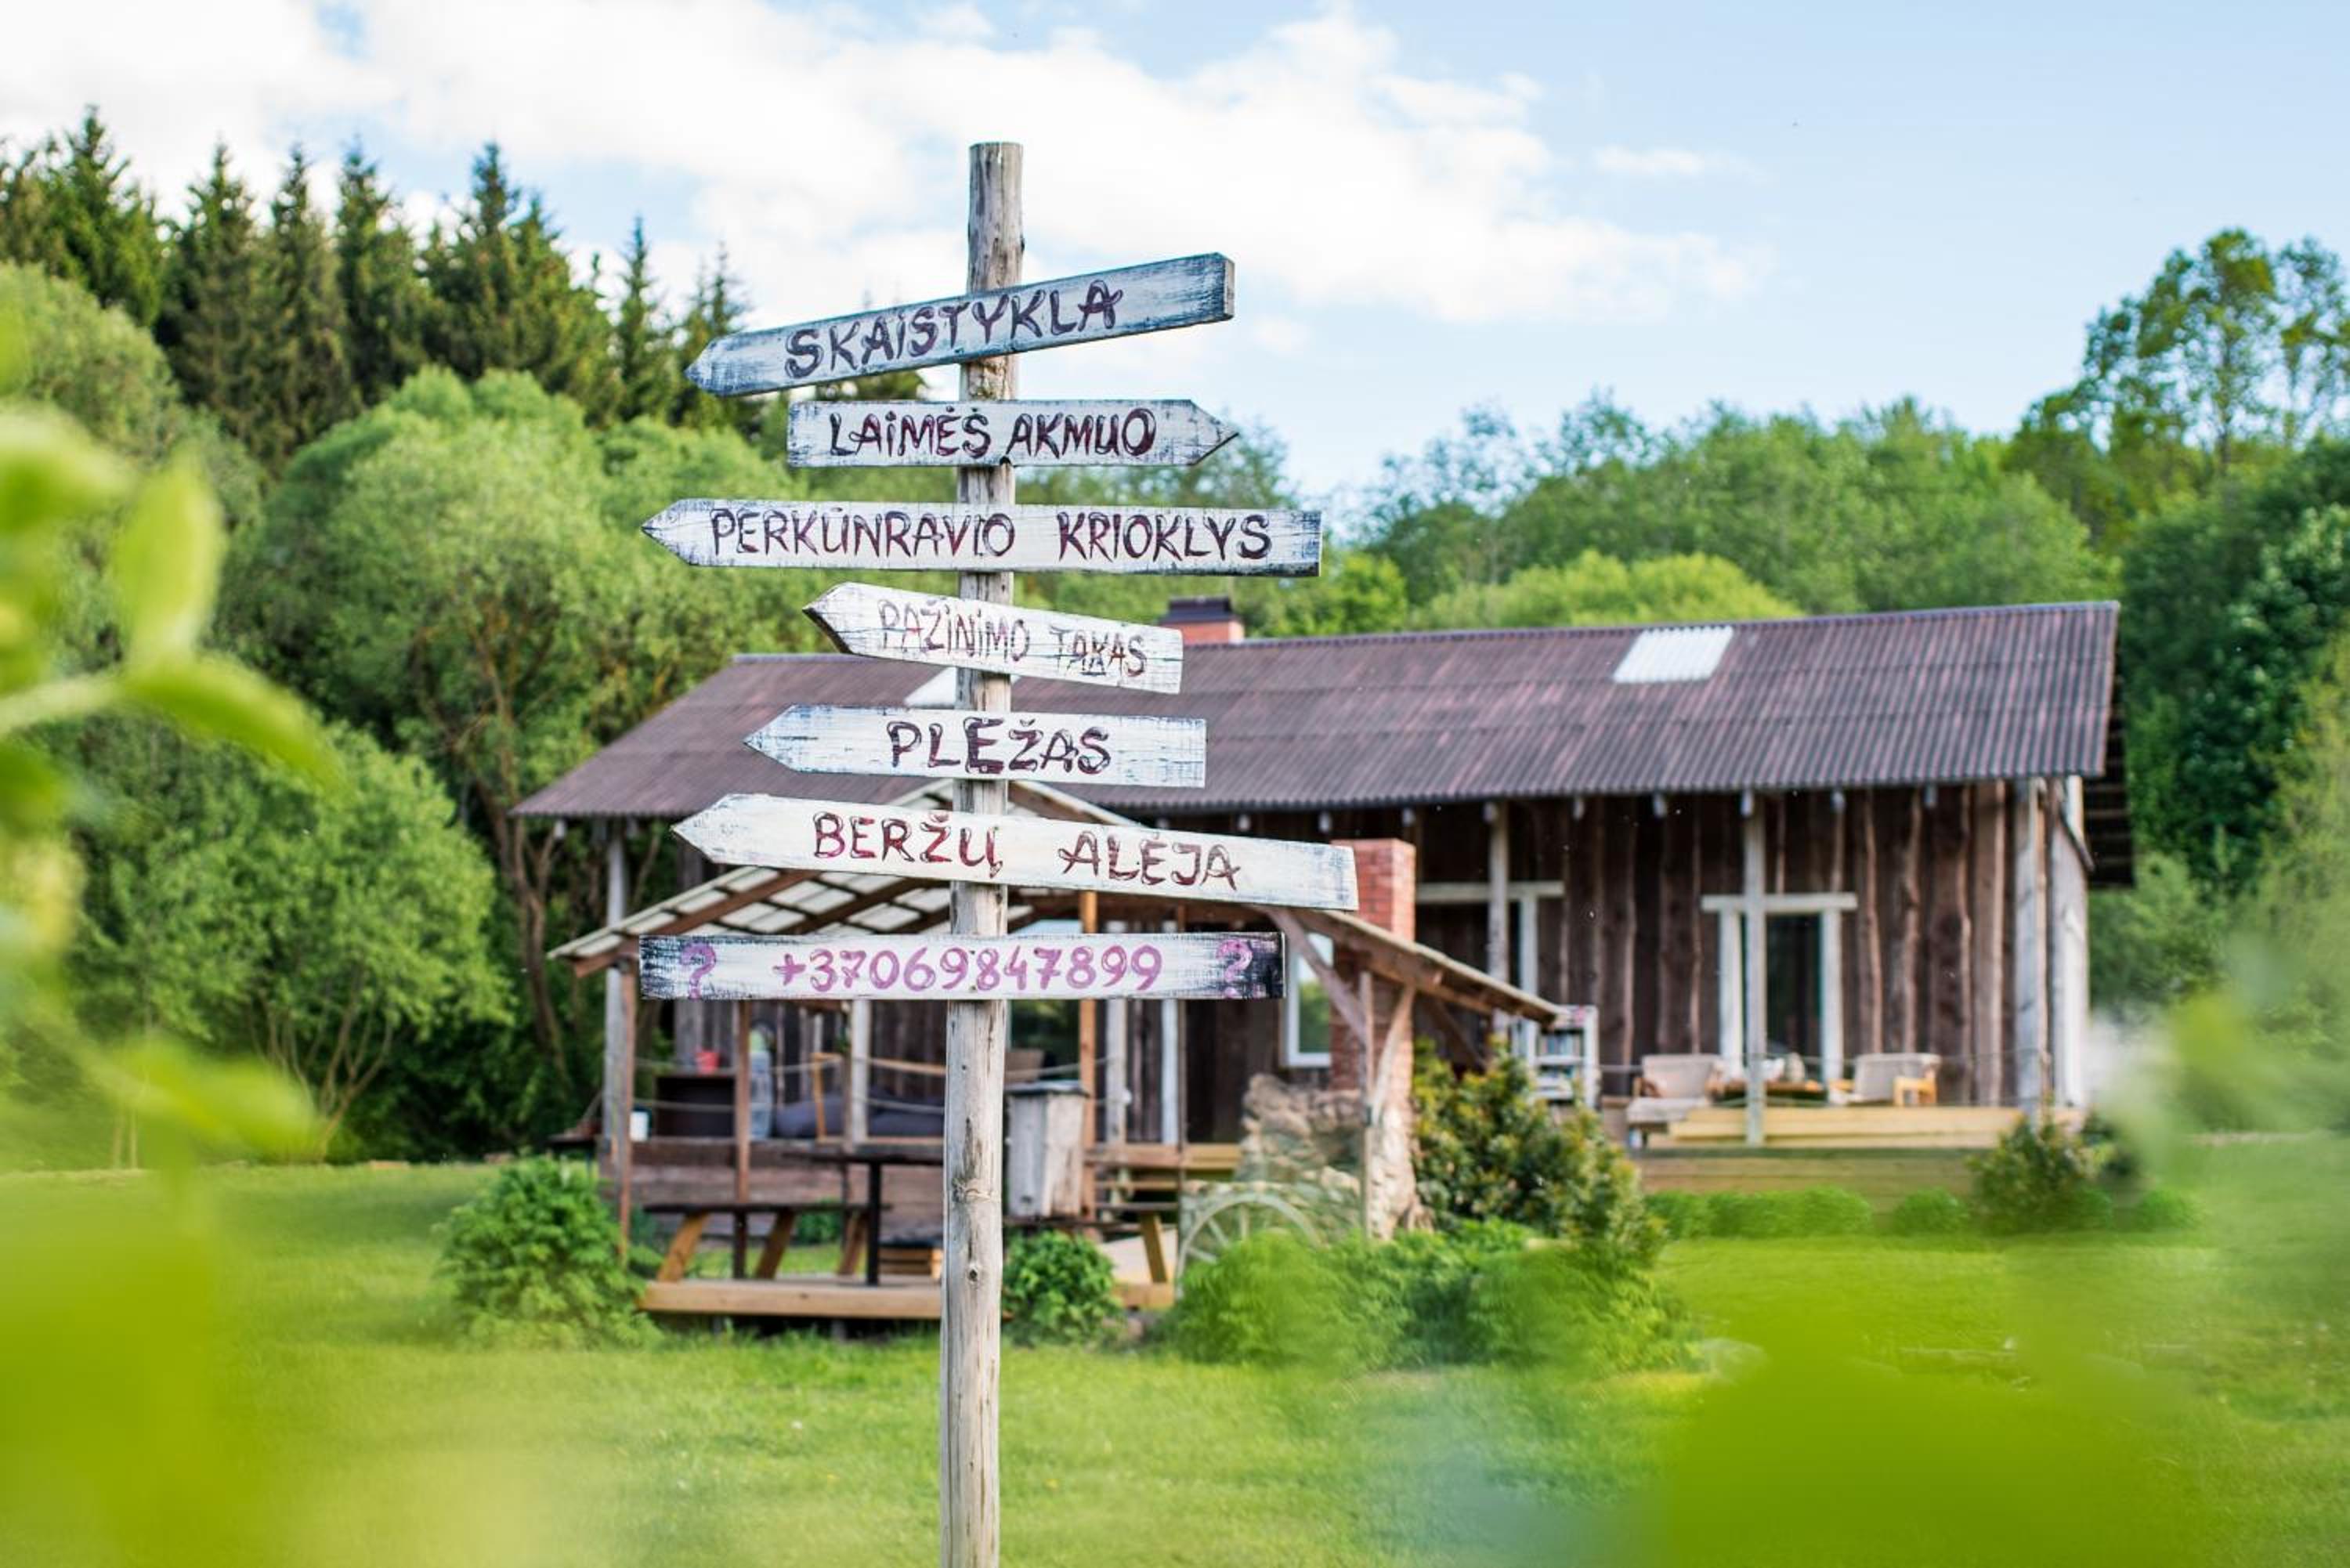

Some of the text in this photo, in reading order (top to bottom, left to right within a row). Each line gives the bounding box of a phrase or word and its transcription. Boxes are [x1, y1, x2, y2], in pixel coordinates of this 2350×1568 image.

[784, 280, 1124, 379] SKAISTYKLA
[1005, 407, 1158, 458] AKMUO
[1056, 511, 1273, 563] KRIOKLYS
[886, 716, 1112, 775] PLEŽAS
[812, 810, 1003, 879] BERŽŲ
[772, 944, 1163, 992] +37069847899
